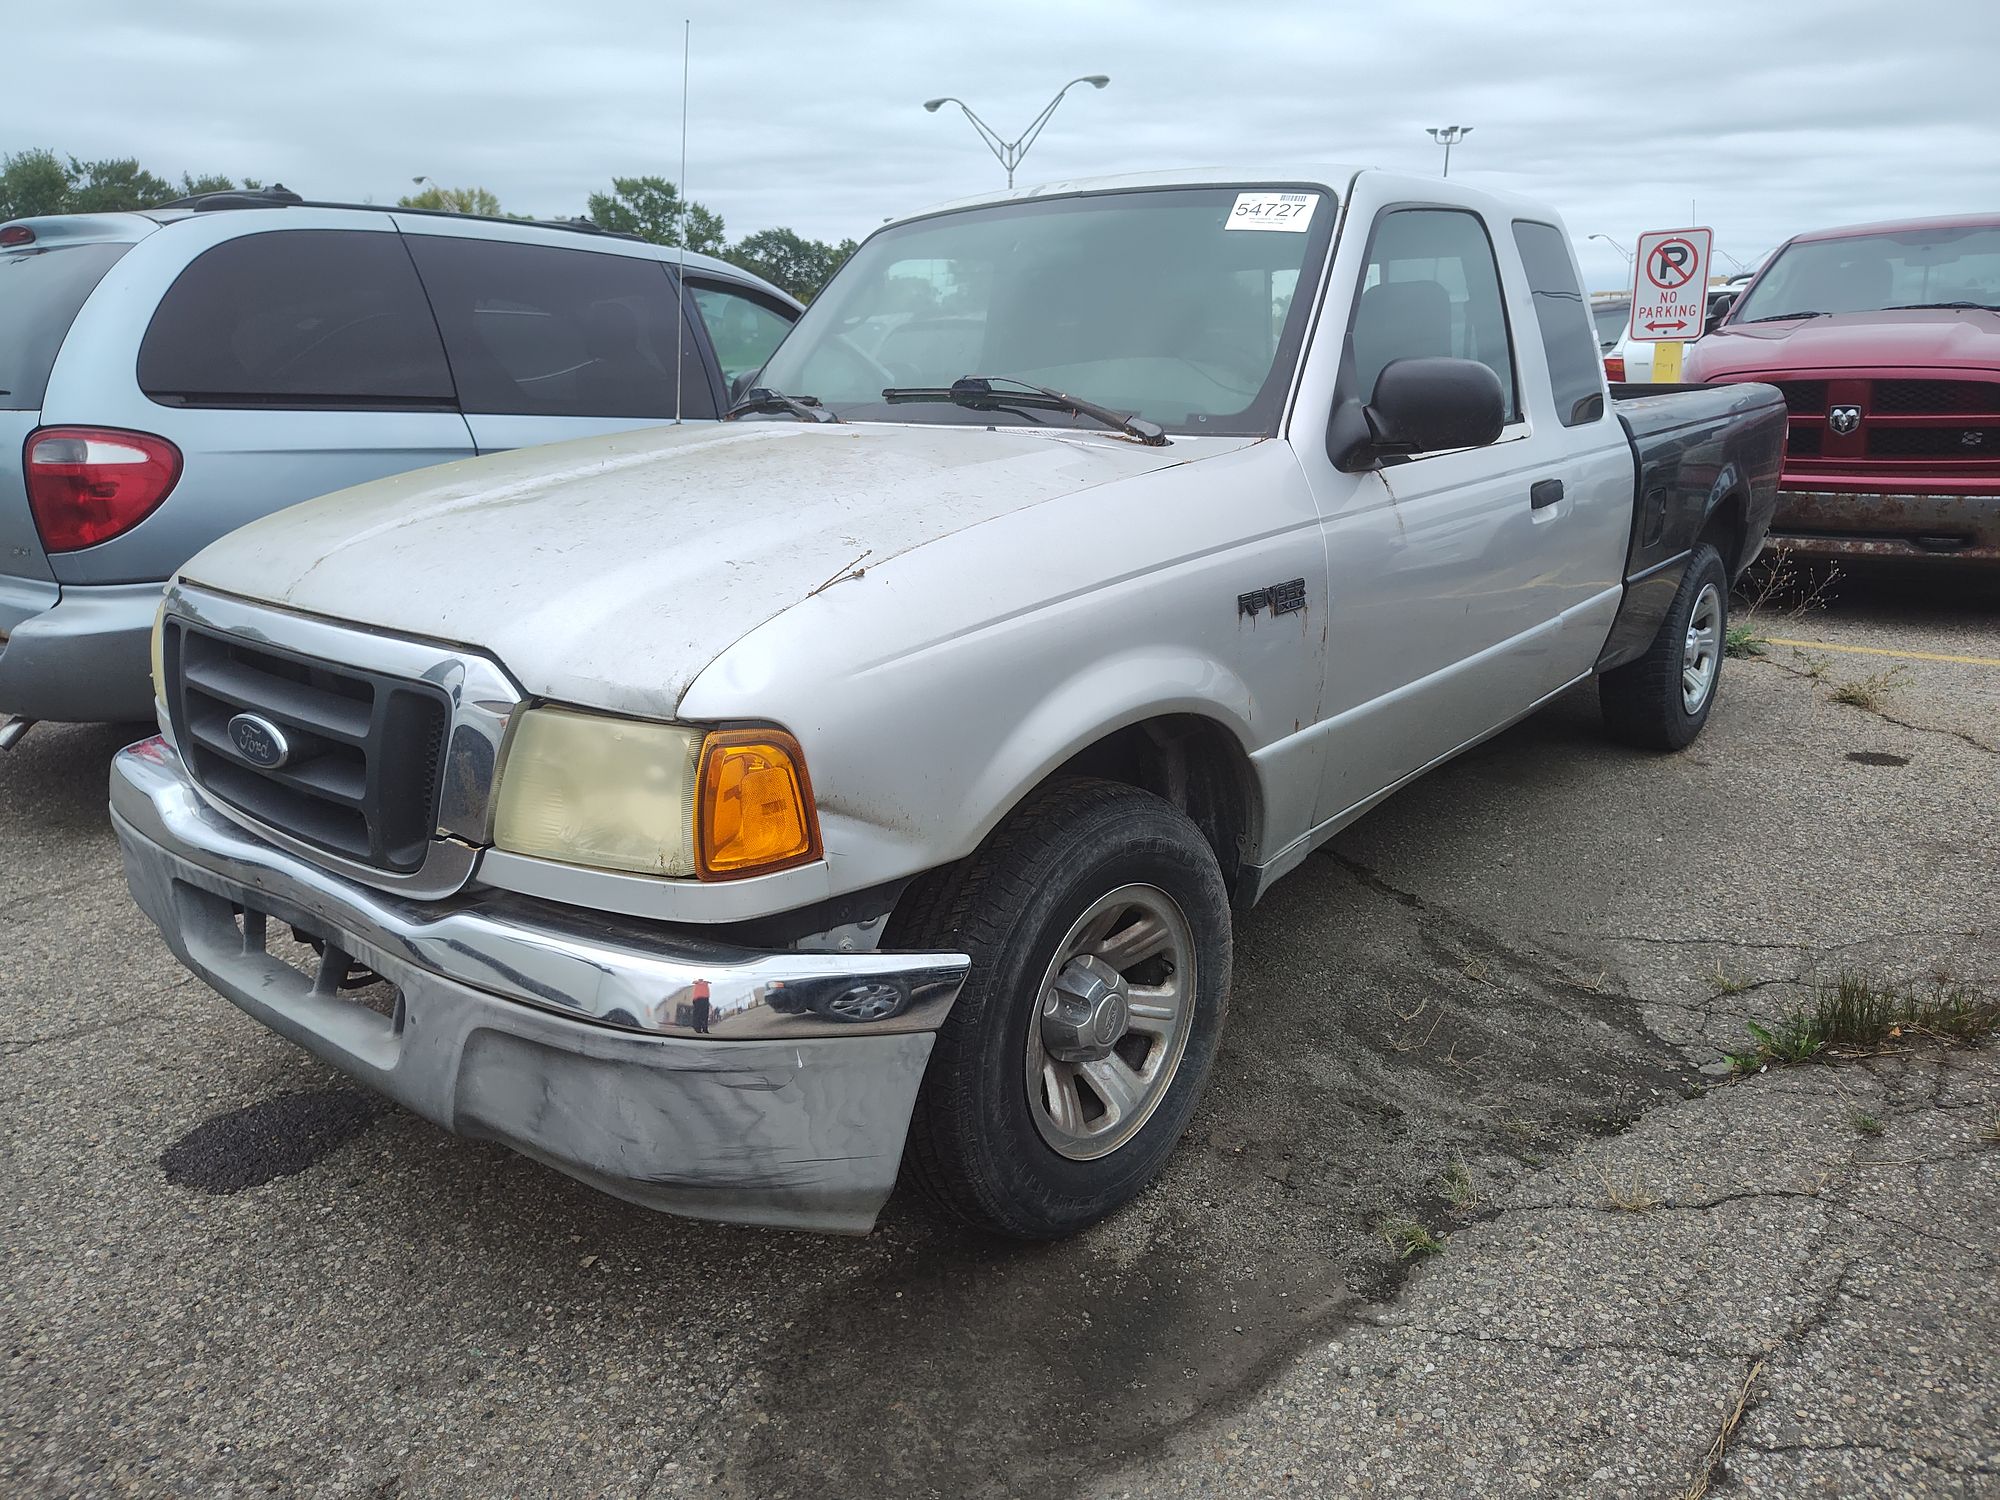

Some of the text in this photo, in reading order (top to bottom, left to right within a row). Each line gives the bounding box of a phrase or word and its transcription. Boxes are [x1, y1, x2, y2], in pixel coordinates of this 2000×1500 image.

[1235, 203, 1307, 217] 54727
[1660, 291, 1678, 304] NO
[1638, 304, 1697, 319] PARKING
[1237, 577, 1306, 616] RANGER
[239, 723, 271, 759] Ford
